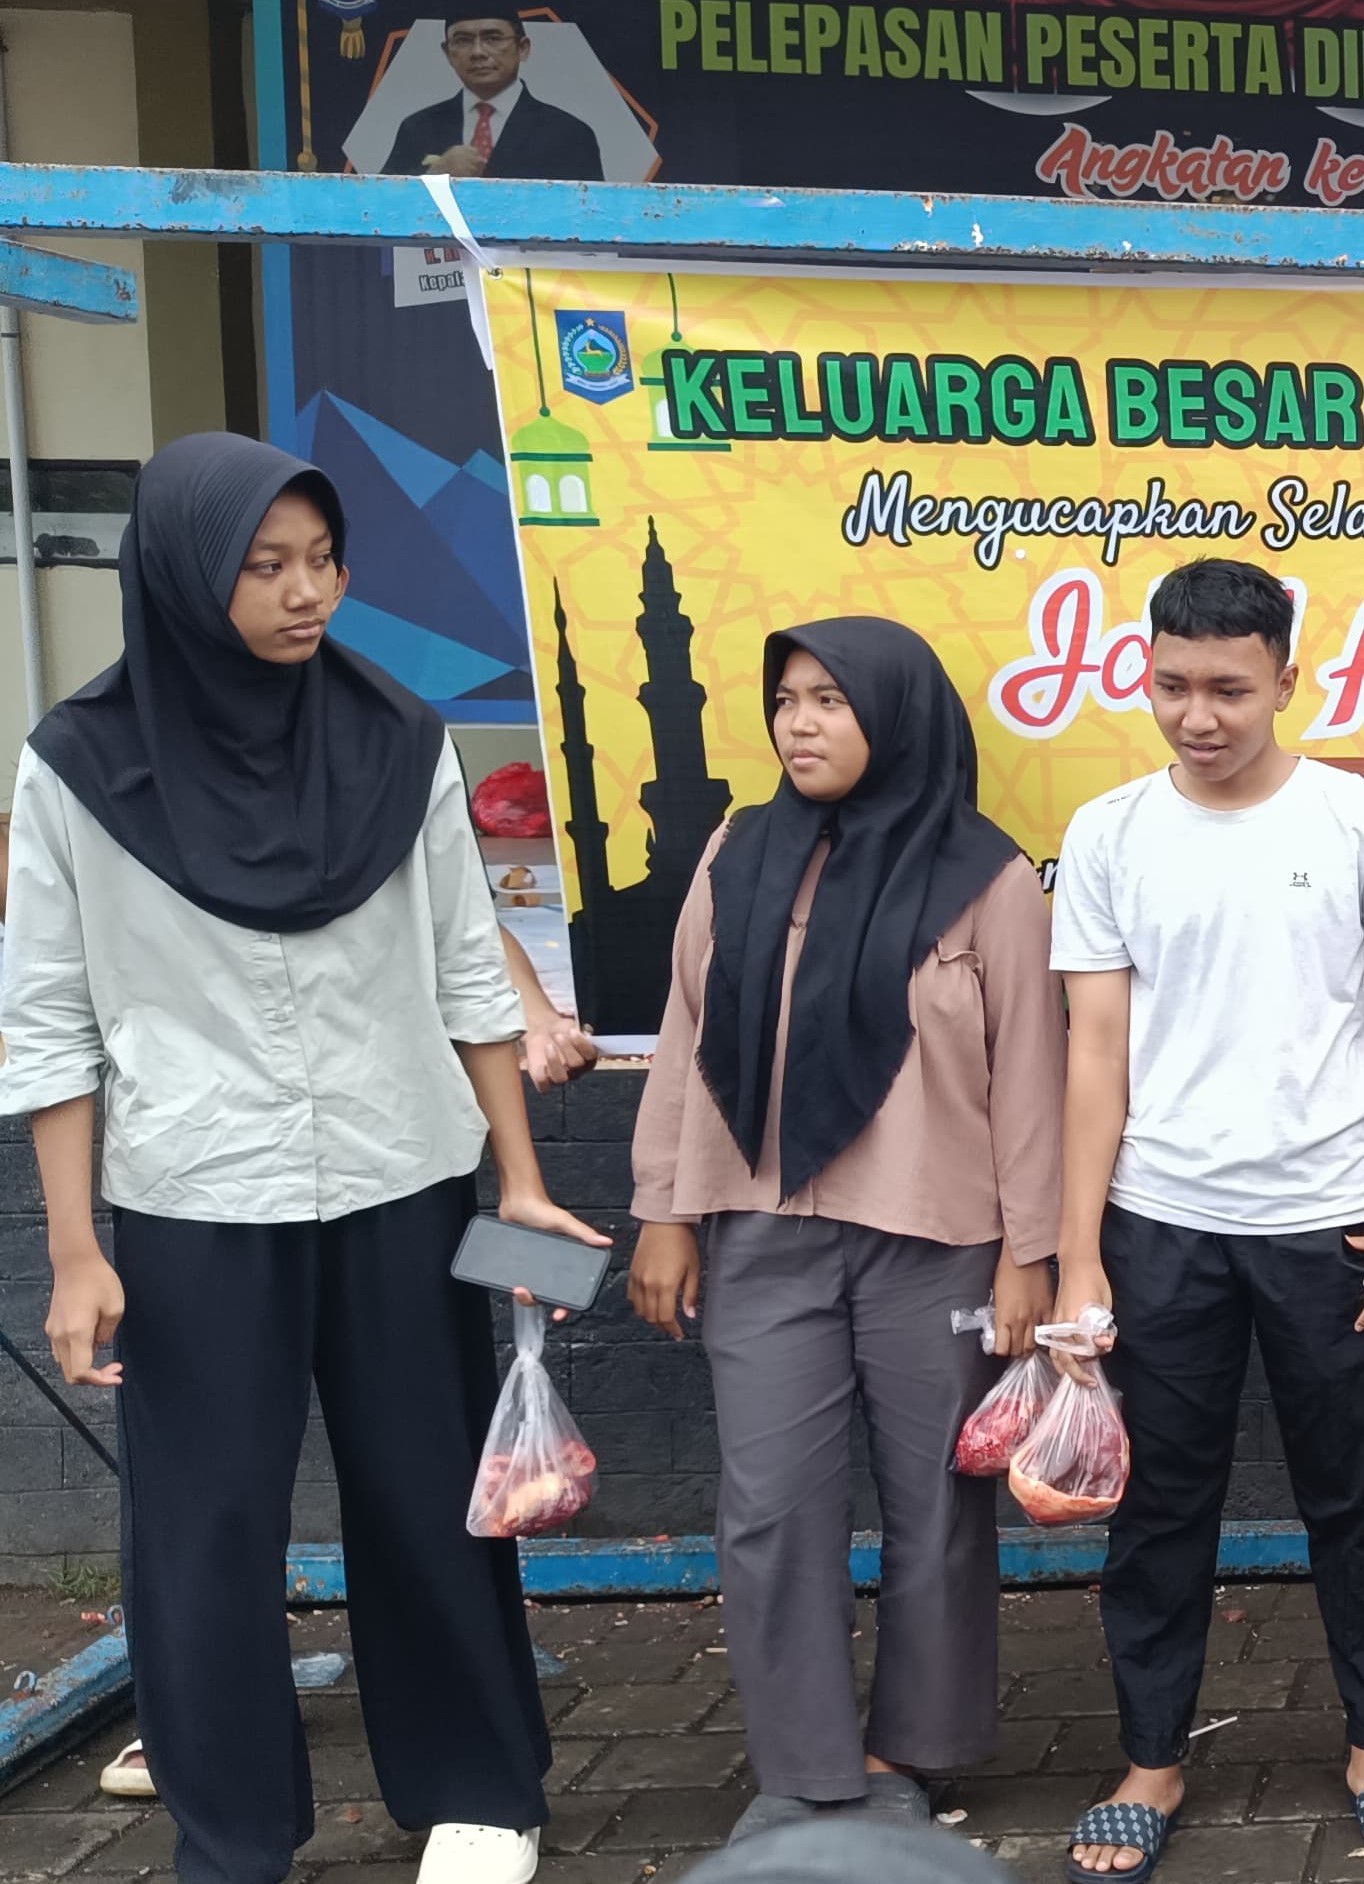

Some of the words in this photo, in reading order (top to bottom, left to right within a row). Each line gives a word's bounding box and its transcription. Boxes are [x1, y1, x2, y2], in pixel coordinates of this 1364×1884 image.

[660, 0, 1003, 84] PELEPASAN
[1025, 14, 1283, 97] PESERTA
[1040, 125, 1287, 199] Angkatan
[664, 352, 1094, 446] KELUARGA
[1113, 360, 1362, 450] BESAR
[844, 472, 1251, 566] Mengucapkan
